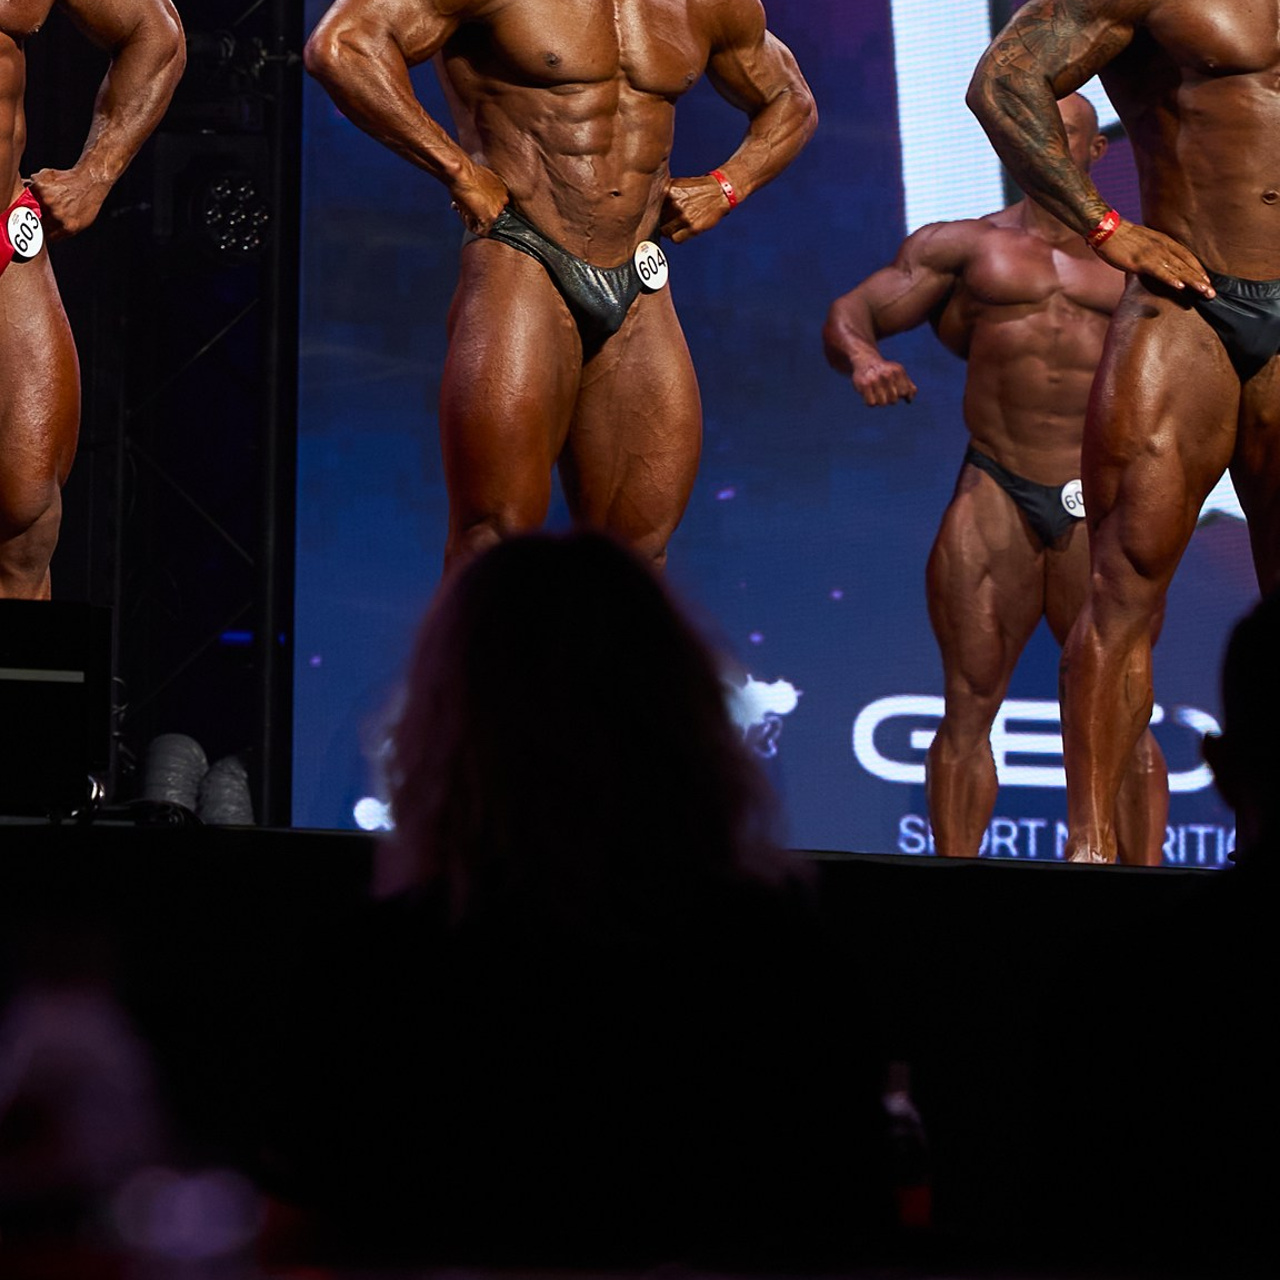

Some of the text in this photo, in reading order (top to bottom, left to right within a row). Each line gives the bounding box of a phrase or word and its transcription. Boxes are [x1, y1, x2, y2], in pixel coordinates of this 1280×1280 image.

[14, 211, 39, 252] 603
[639, 248, 666, 281] 604
[1065, 490, 1084, 510] 60
